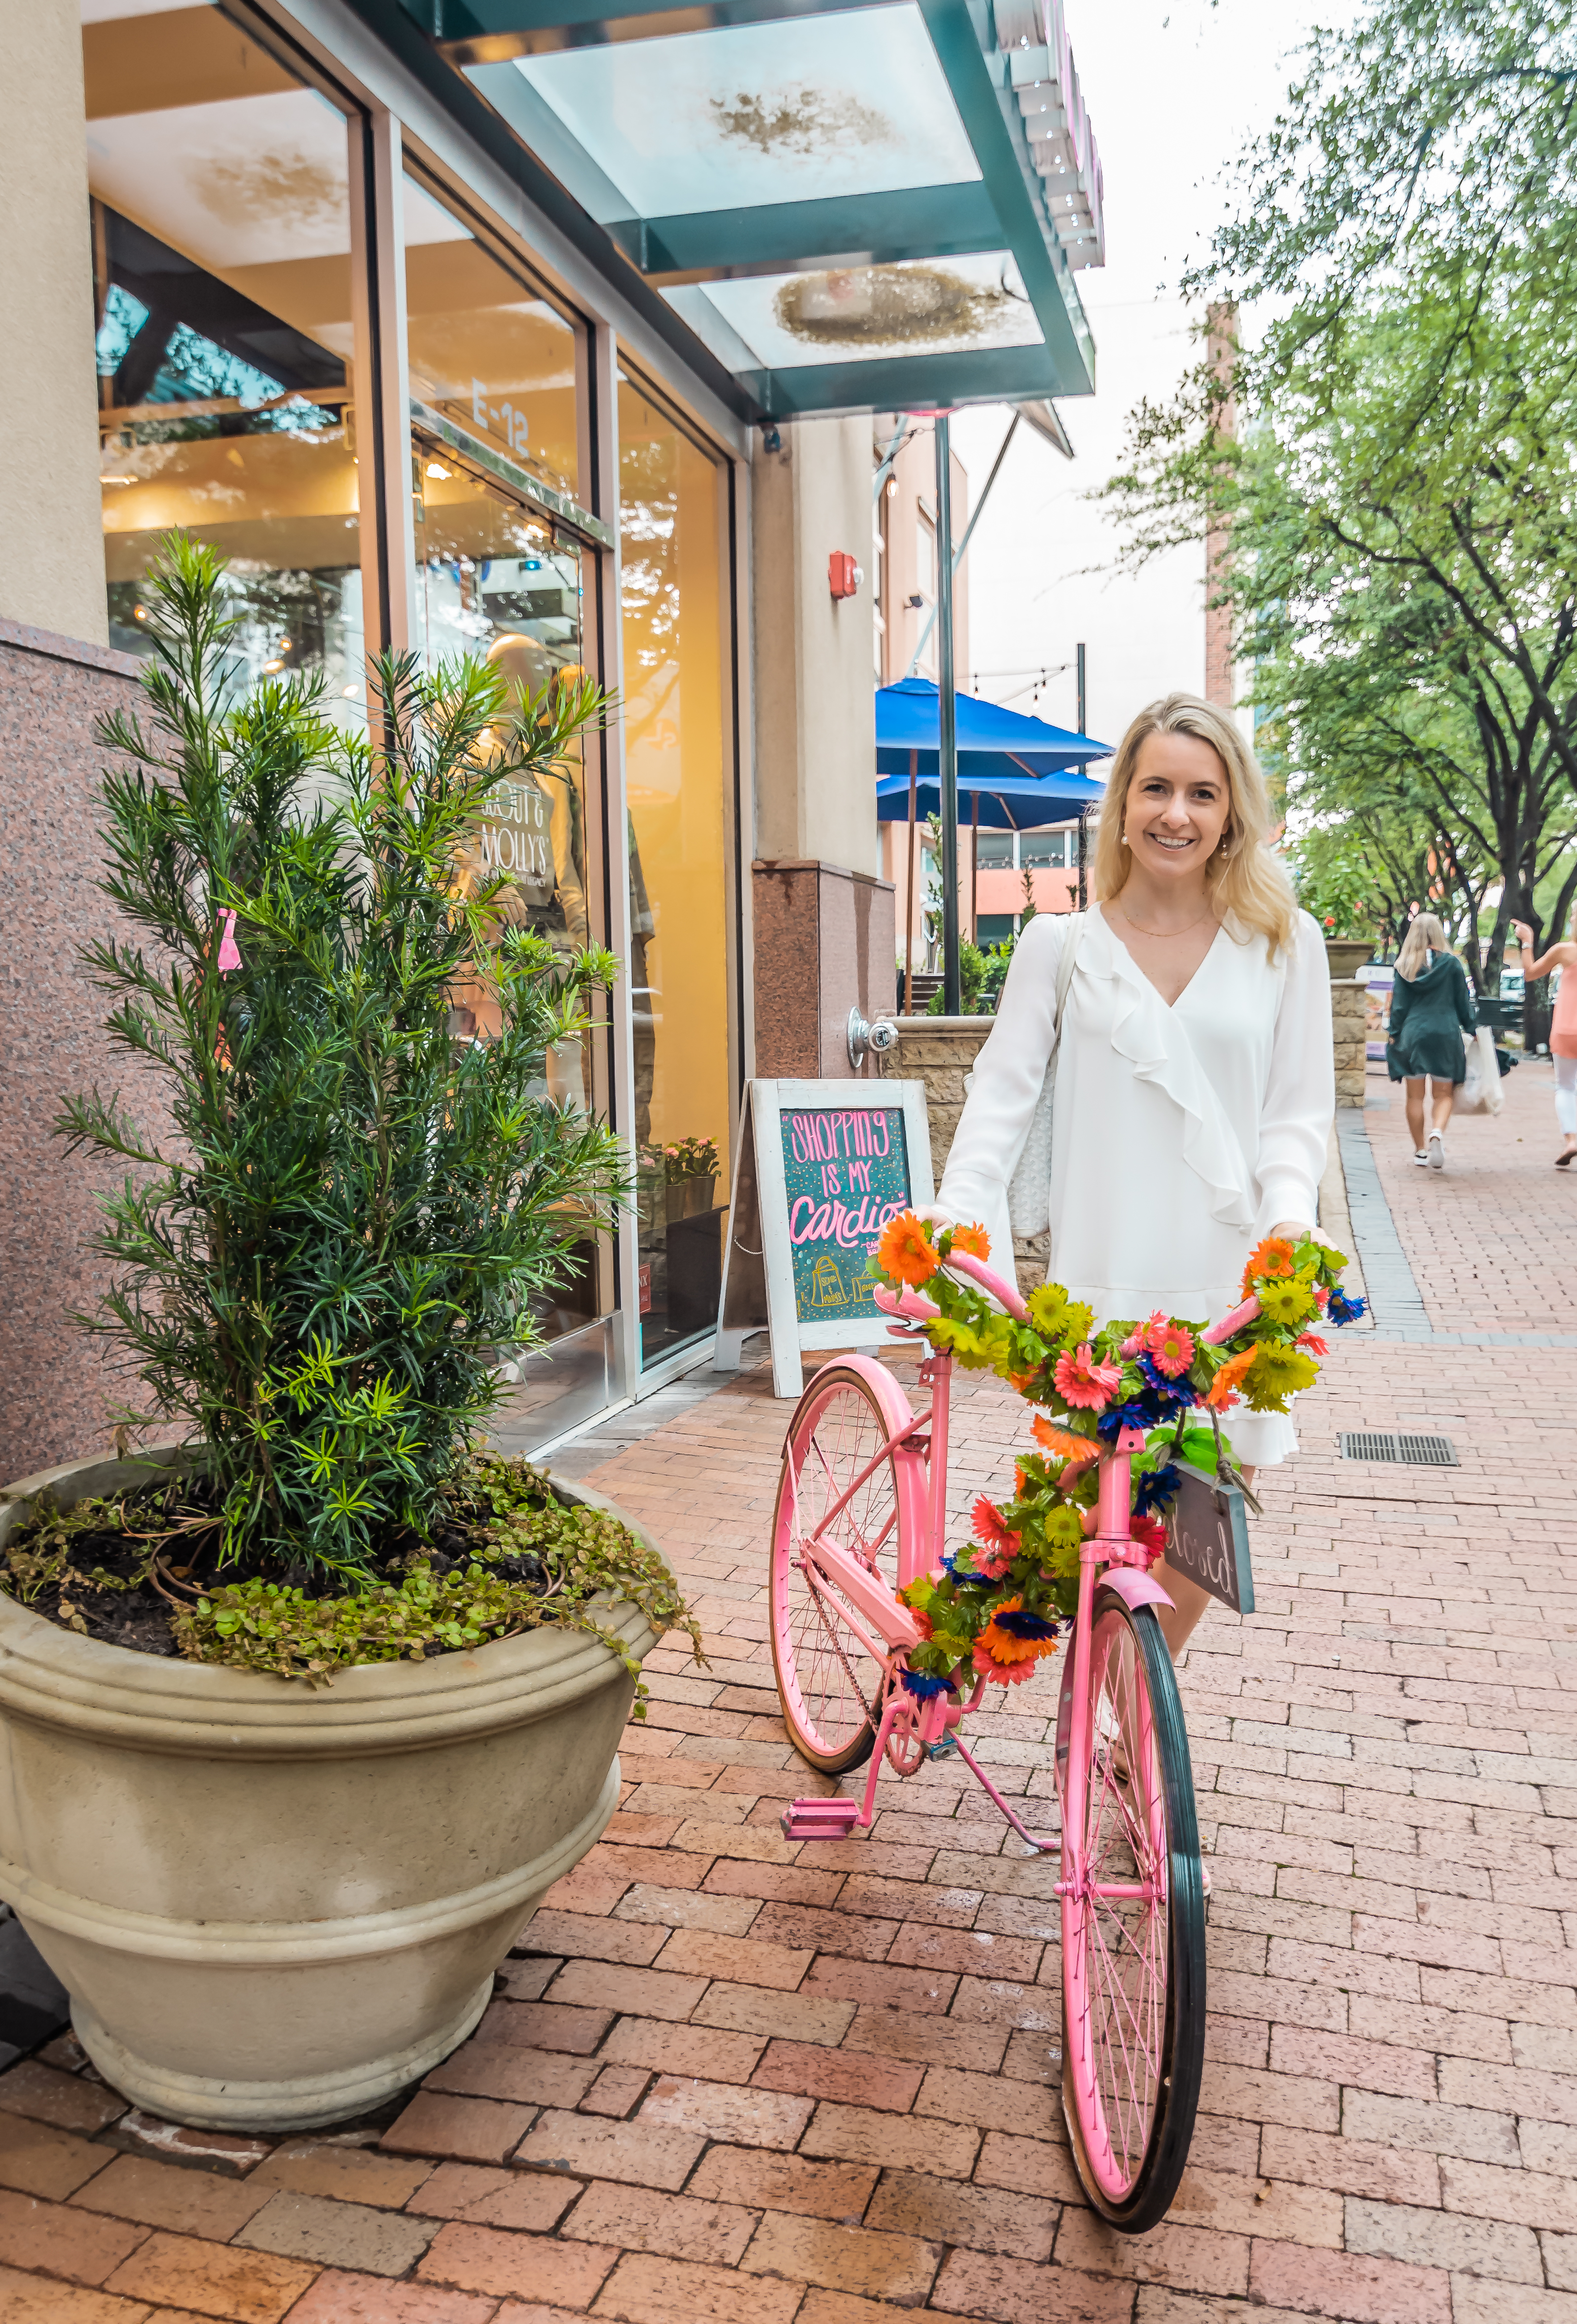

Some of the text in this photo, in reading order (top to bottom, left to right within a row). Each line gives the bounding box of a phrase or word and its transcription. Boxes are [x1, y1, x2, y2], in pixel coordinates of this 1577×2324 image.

[472, 377, 529, 459] E-12
[481, 823, 546, 875] MOLLY'S
[821, 1160, 873, 1198] IS MY
